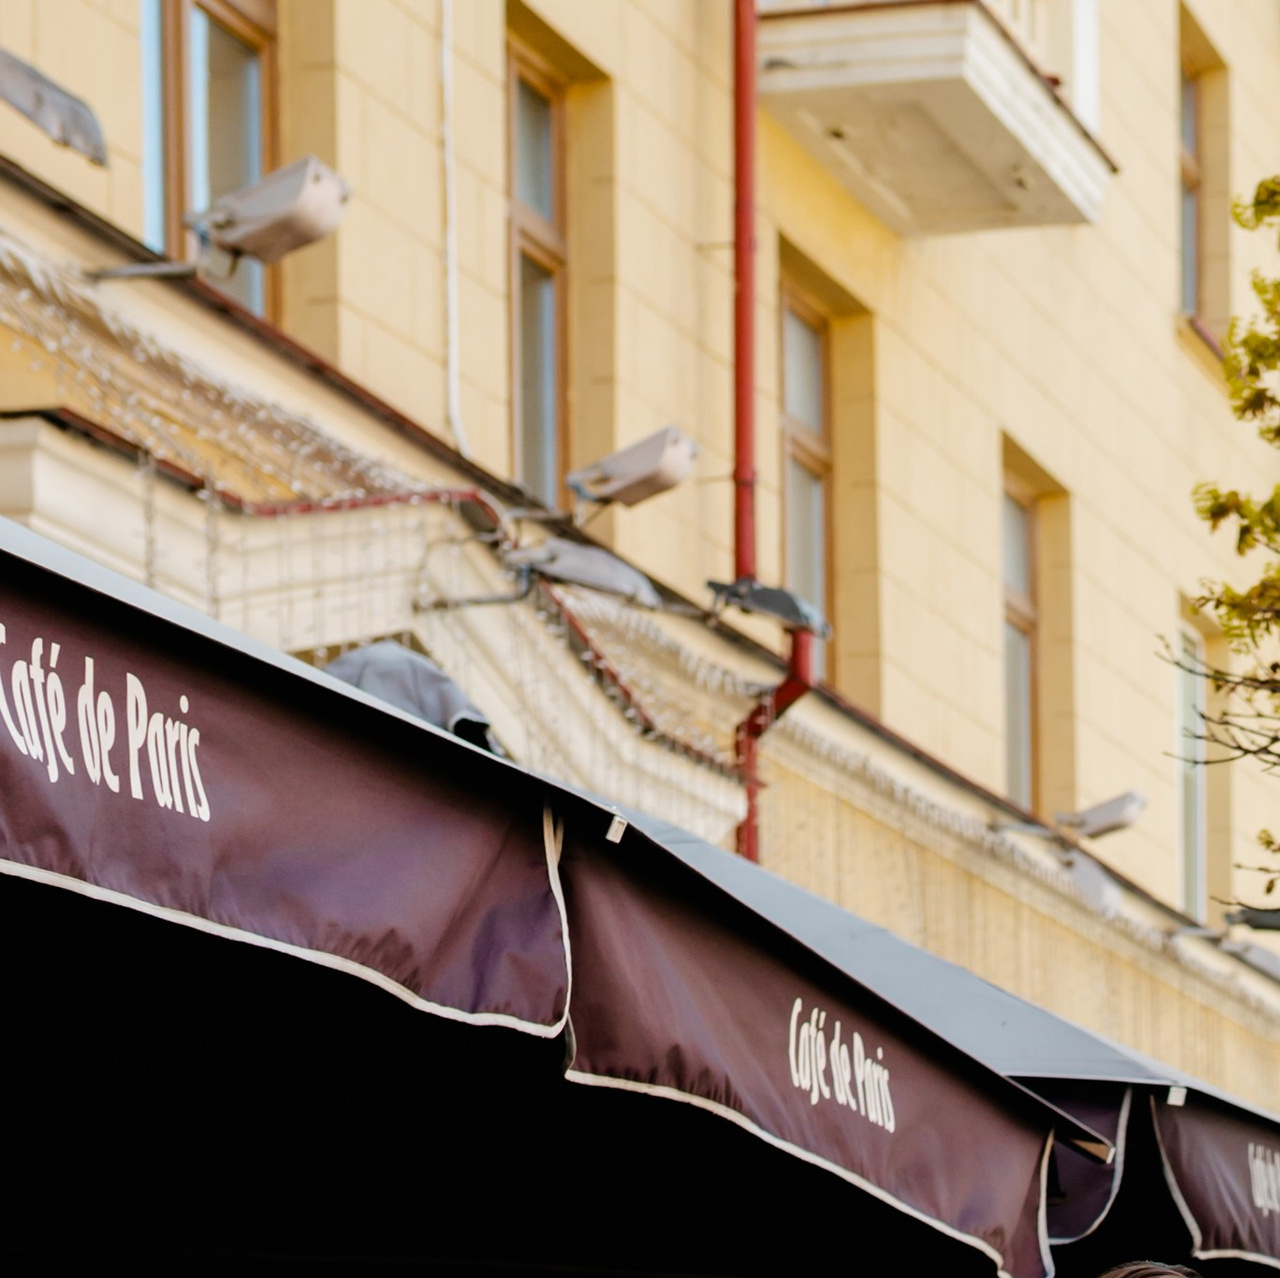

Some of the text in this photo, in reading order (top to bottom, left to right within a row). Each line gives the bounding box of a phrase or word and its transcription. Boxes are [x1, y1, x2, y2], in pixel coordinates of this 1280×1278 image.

[77, 656, 120, 793] de
[126, 672, 211, 822] Paris
[789, 997, 896, 1134] Café de Paris
